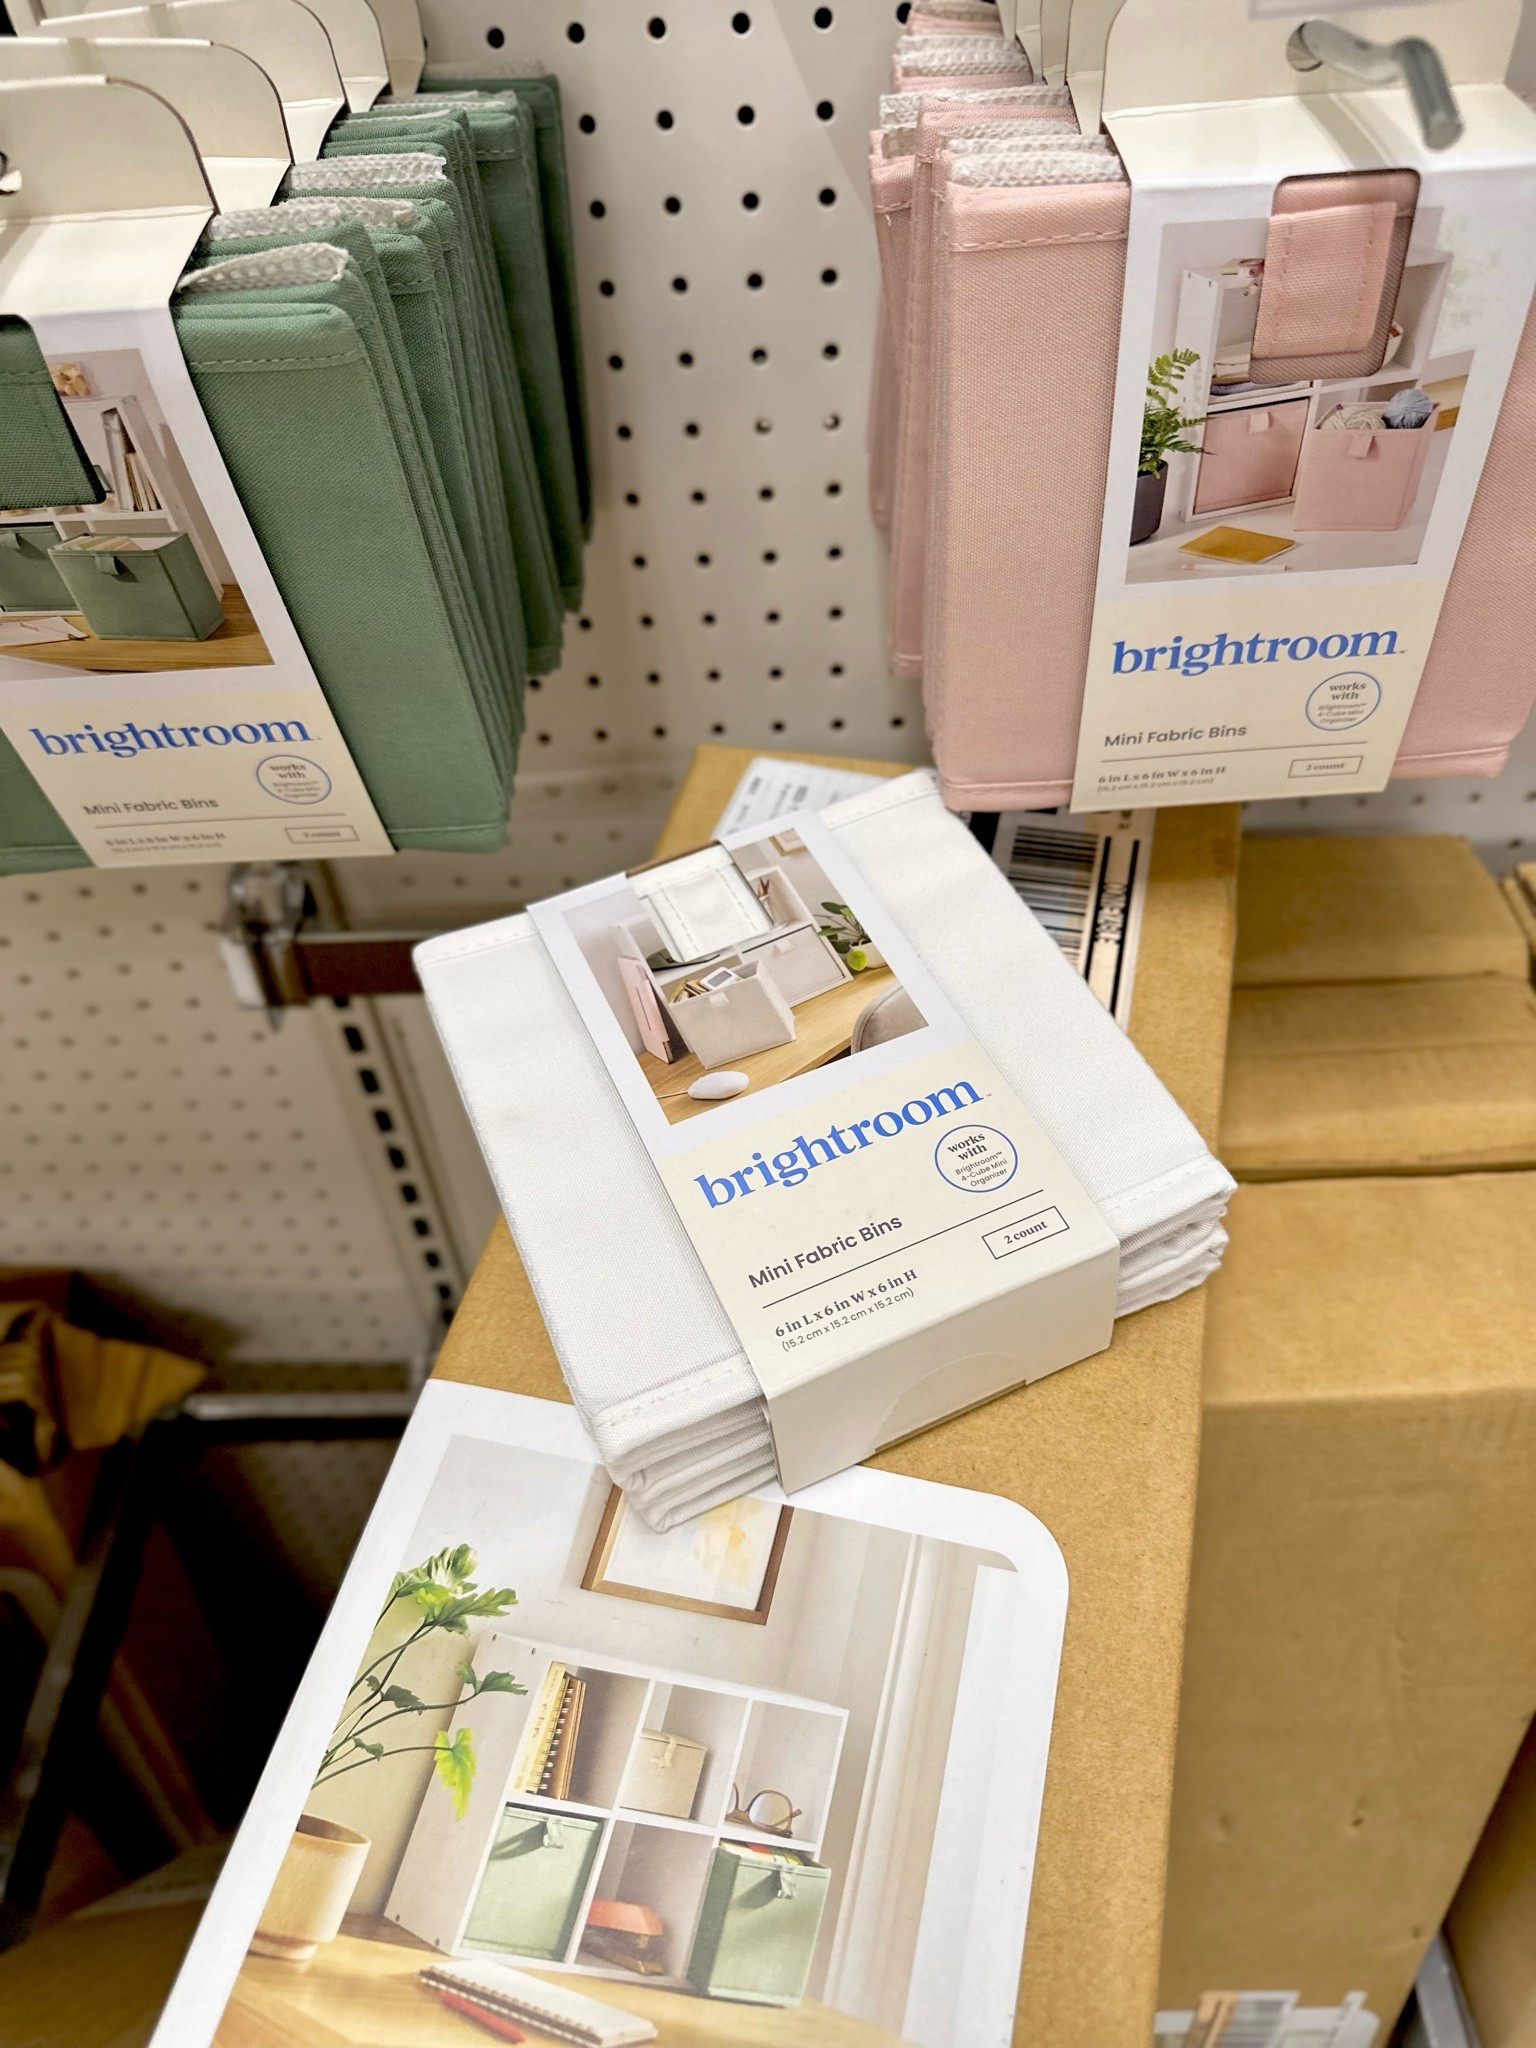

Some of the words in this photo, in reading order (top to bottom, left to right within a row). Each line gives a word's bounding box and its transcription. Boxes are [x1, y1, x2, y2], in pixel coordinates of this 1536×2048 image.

[1112, 630, 1398, 677] brightroom
[1329, 682, 1366, 691] works
[1331, 692, 1359, 700] with
[29, 719, 314, 758] brightroom
[1104, 732, 1143, 747] Mini
[1147, 728, 1204, 743] Fabric
[1208, 725, 1247, 739] Bins
[1108, 775, 1121, 783] in
[1141, 772, 1149, 780] 6
[1151, 771, 1164, 779] in
[1167, 770, 1179, 778] W
[1190, 768, 1198, 776] 6
[1201, 767, 1213, 775] in
[83, 803, 121, 815] Mini
[123, 800, 179, 812] Fabric
[180, 799, 220, 810] Bins
[693, 1081, 985, 1208] brightroom
[947, 1133, 986, 1153] works
[957, 1144, 988, 1161] with
[961, 1166, 991, 1181] 4-Cube
[990, 1158, 1008, 1169] Mini
[970, 1168, 1007, 1187] Organizer
[1003, 1235, 1013, 1245] 2
[1013, 1220, 1049, 1241] count
[748, 1258, 794, 1288] Mini
[794, 1236, 858, 1269] Fabric
[858, 1217, 903, 1242] Bins
[775, 1326, 785, 1337] 6
[785, 1321, 803, 1333] in
[802, 1314, 813, 1326] L
[813, 1311, 824, 1321] x
[824, 1305, 834, 1316] 6
[833, 1300, 851, 1312] in
[850, 1291, 865, 1304] W
[867, 1288, 877, 1298] x
[877, 1282, 887, 1293] 6
[887, 1278, 904, 1289] in
[903, 1269, 918, 1282] H
[782, 1335, 806, 1352] (15.2
[806, 1328, 823, 1341] cm
[823, 1326, 831, 1334] x
[830, 1316, 850, 1330] 15.2
[850, 1309, 867, 1321] cm
[867, 1306, 875, 1315] x
[874, 1297, 893, 1311] 15.2
[893, 1287, 915, 1303] cm)
